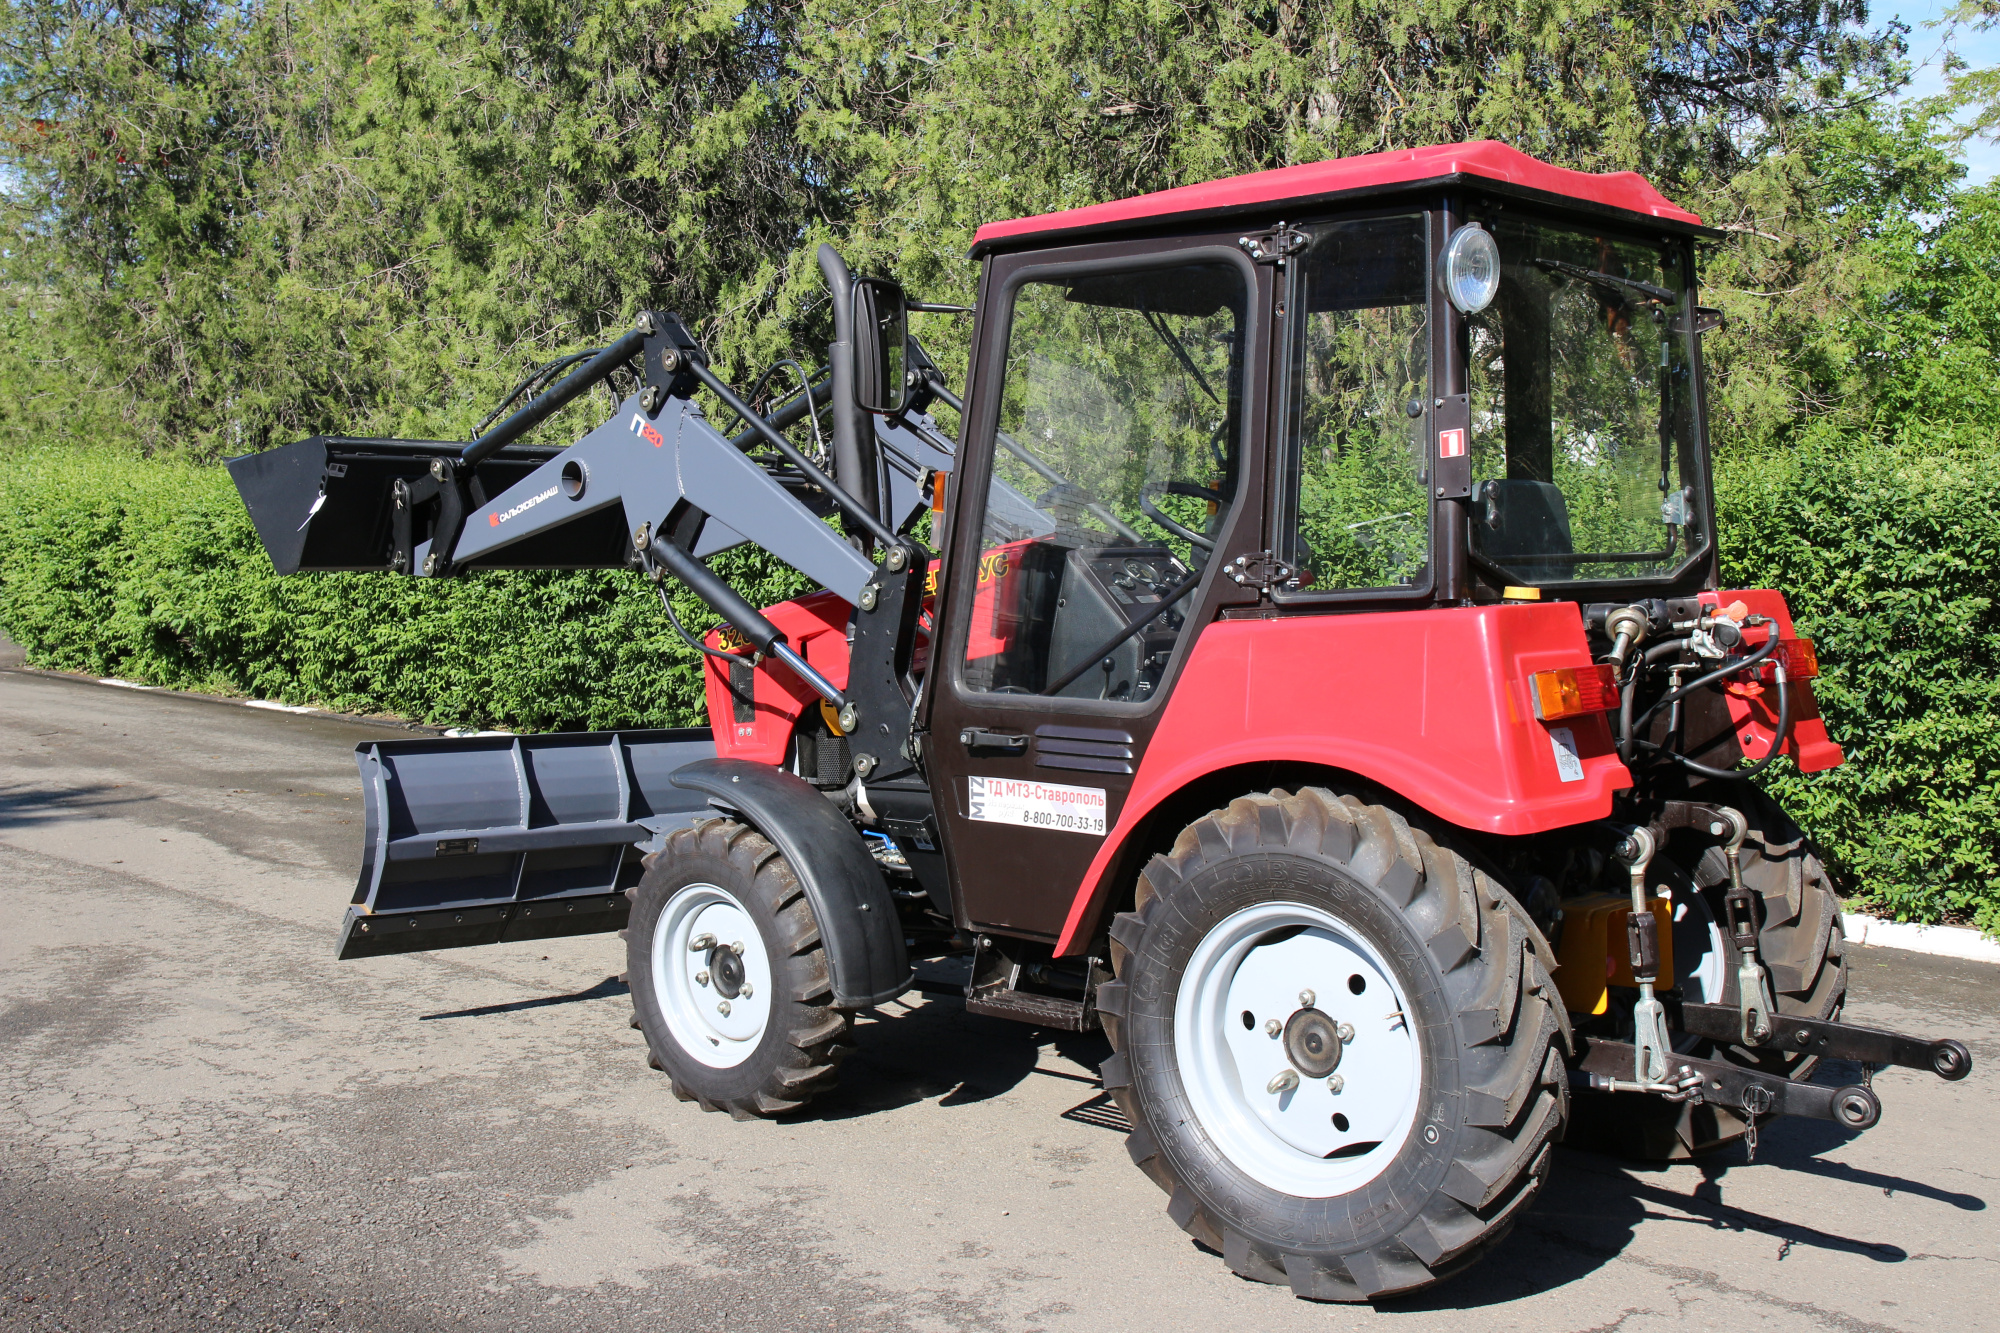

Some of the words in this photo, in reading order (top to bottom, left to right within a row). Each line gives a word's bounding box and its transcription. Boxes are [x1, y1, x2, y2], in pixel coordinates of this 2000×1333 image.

[499, 485, 559, 523] САЛЬСКСЕЛЬМАШ
[970, 776, 985, 819] MTZ
[987, 780, 1003, 798] ТД
[1006, 782, 1104, 807] МТЗ-Ставрополь
[1023, 810, 1104, 832] 8-800-700-33-19
[1268, 860, 1421, 977] BELSHINA
[1223, 1194, 1336, 1243] 11.2-20
